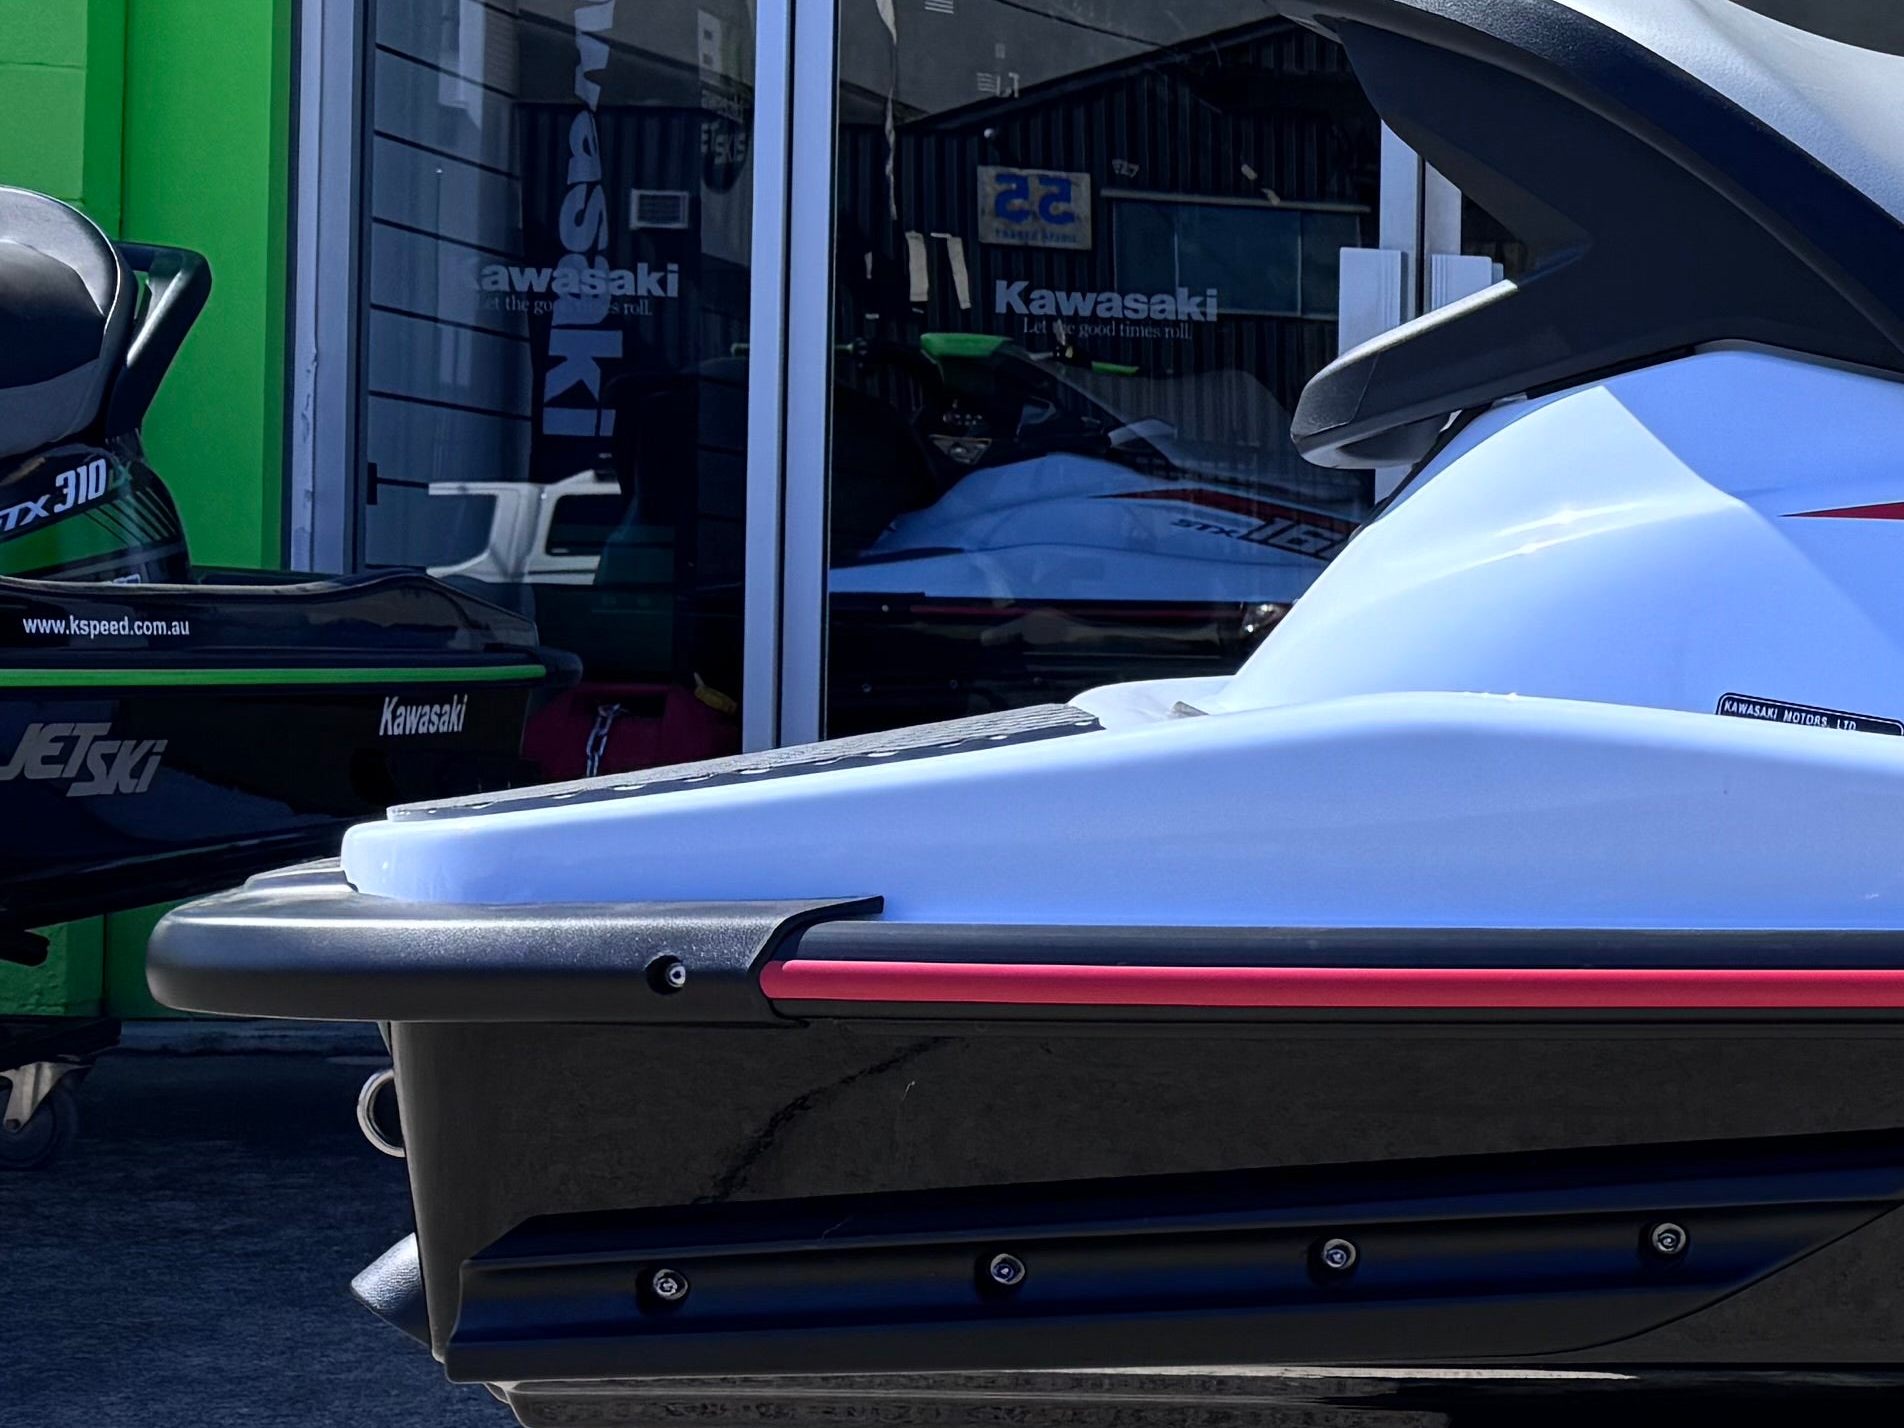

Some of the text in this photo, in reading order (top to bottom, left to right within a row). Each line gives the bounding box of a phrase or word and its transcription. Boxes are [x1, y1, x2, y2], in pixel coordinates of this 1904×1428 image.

[464, 257, 679, 298] awasaki
[995, 280, 1218, 322] Kawasaki
[0, 458, 107, 532] TX 310
[22, 616, 190, 640] www.kspeed.com.au
[379, 693, 468, 737] Kawasaki
[1724, 699, 1778, 721] KAWASAKI
